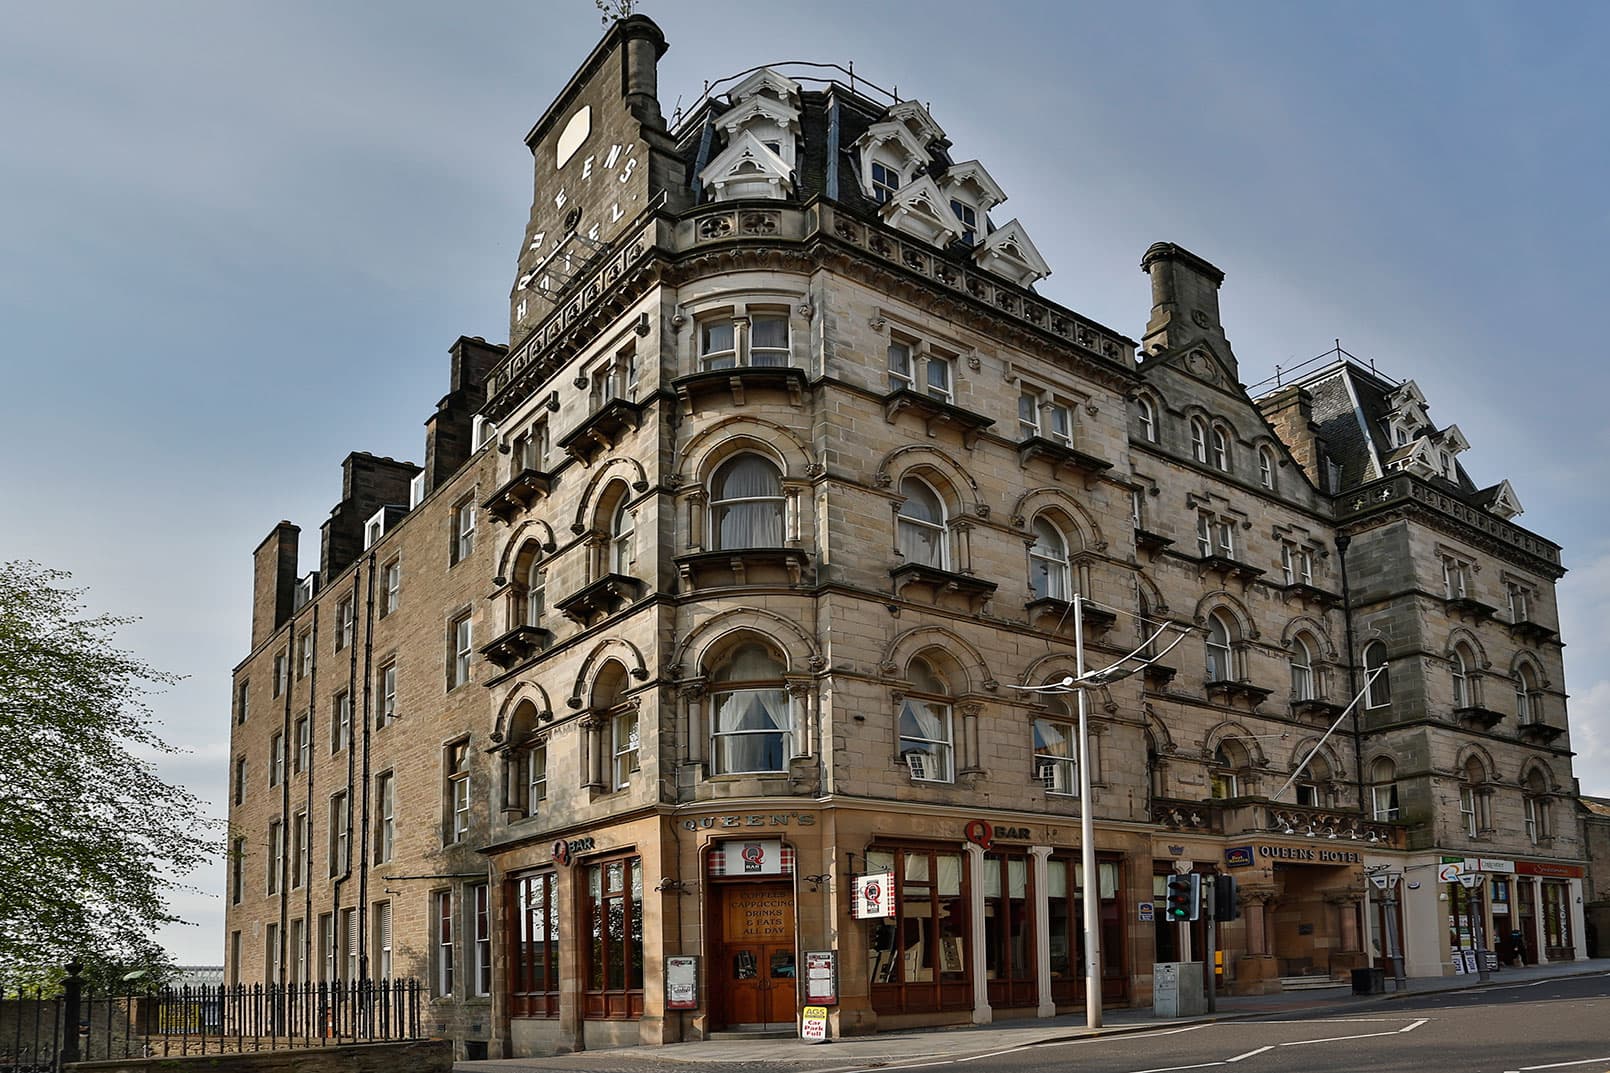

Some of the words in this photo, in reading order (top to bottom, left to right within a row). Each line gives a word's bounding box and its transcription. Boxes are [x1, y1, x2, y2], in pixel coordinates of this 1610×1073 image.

[683, 811, 816, 832] QUEEN'S
[964, 819, 993, 849] Q
[994, 826, 1031, 840] BAR
[551, 839, 572, 867] Q
[569, 836, 596, 853] BAR
[741, 845, 766, 865] Q
[1259, 846, 1316, 860] QUEENS
[1321, 850, 1361, 863] HOTEL
[865, 883, 881, 905] Q
[745, 909, 783, 918] DRINKS
[746, 919, 753, 927] &
[757, 918, 783, 926] EATS
[764, 927, 785, 935] DAY
